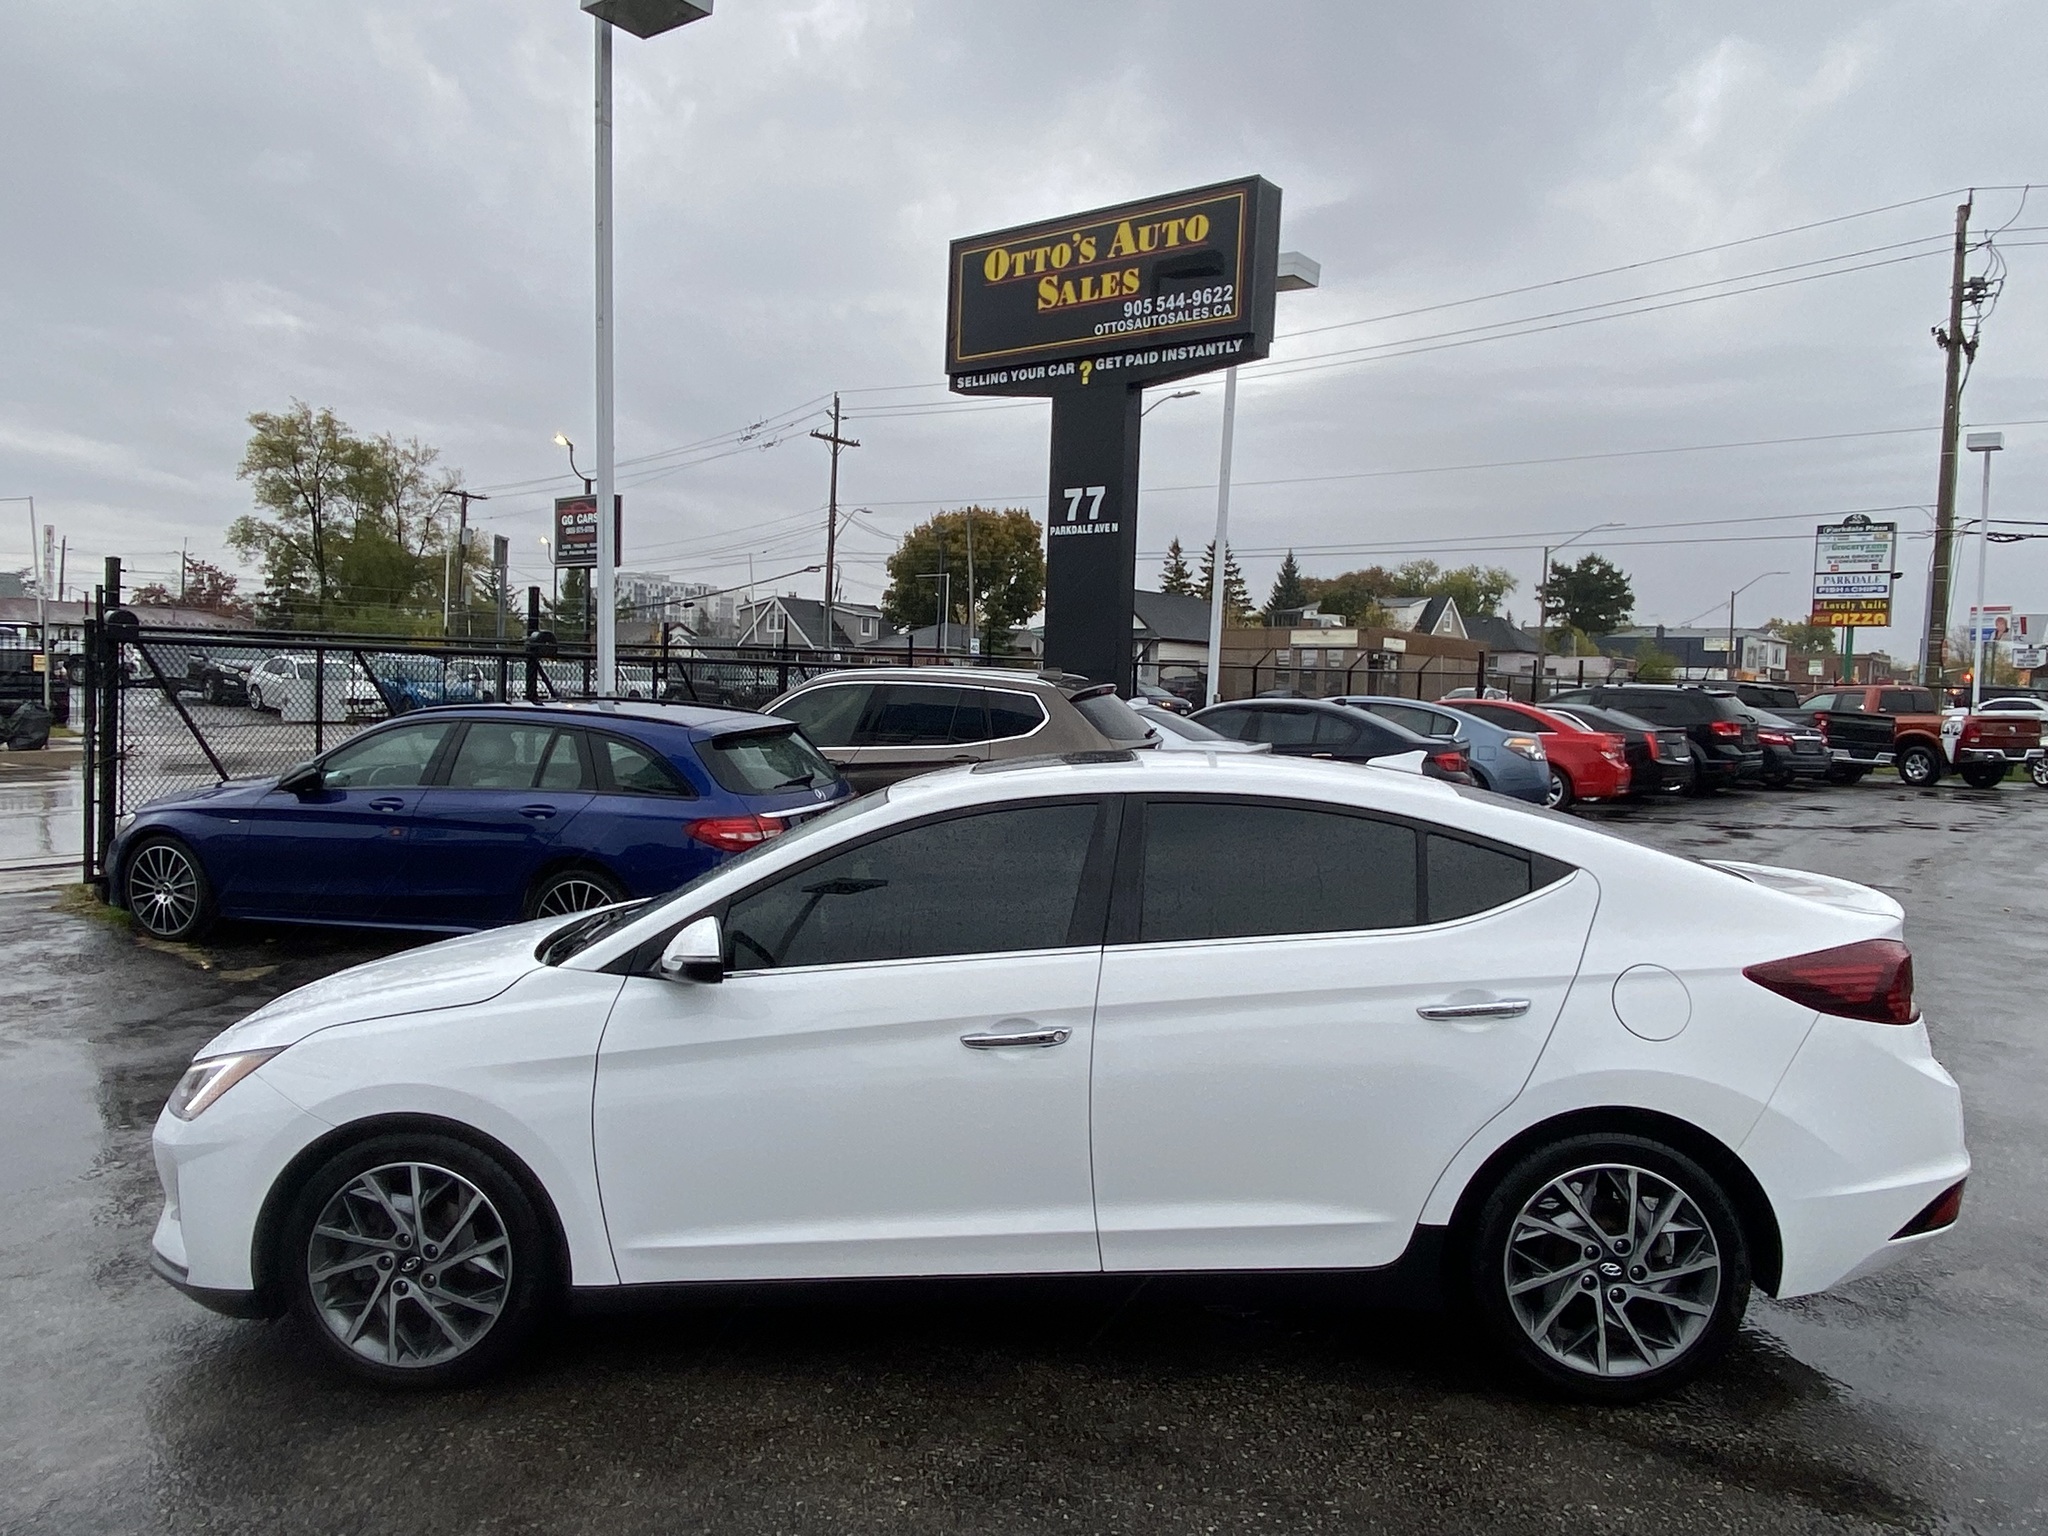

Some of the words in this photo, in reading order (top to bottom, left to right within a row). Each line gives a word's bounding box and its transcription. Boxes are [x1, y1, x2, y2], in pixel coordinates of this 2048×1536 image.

[984, 233, 1097, 282] OTTO'S
[1108, 214, 1210, 258] AUTO
[1037, 267, 1140, 310] SALES
[1123, 299, 1153, 318] 905
[1156, 285, 1234, 312] 544-9622
[1093, 304, 1232, 336] OTTOSAUTOSALES.CA
[956, 372, 1008, 389] SELLING
[1010, 367, 1046, 383] YOUR
[1048, 362, 1075, 378] CAR
[1079, 360, 1093, 385] ?
[1095, 355, 1122, 371] GET
[1125, 351, 1159, 367] PAID
[1162, 339, 1243, 361] INSTANTLY
[1064, 486, 1106, 521] 77
[577, 513, 598, 524] CARS
[1050, 525, 1093, 536] PARKDALE
[1094, 524, 1110, 533] AVE
[1112, 523, 1119, 532] N
[1824, 525, 1864, 534] Parkdale
[1823, 575, 1881, 584] PARKDALE
[1823, 600, 1856, 611] Lovely
[1859, 599, 1887, 609] Nails
[1831, 613, 1886, 625] PIZZA
